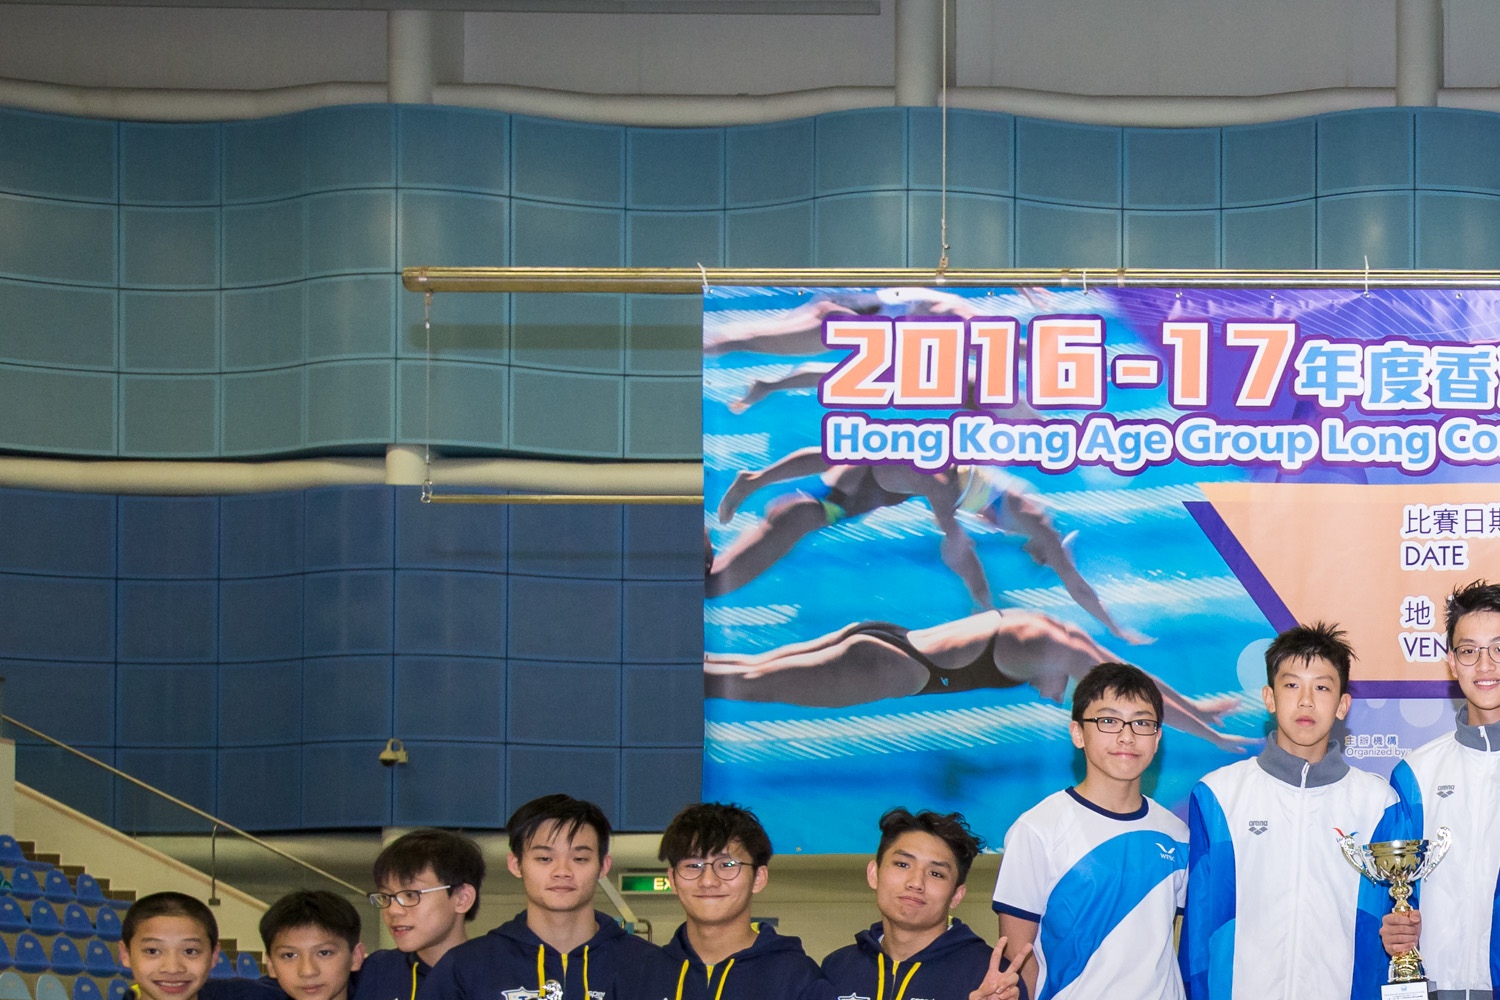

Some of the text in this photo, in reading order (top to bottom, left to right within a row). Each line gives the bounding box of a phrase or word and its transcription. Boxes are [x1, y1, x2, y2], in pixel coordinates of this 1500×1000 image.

[824, 321, 1296, 406] 2016-17
[832, 422, 944, 460] Hong
[959, 422, 1070, 462] Kong
[1084, 423, 1167, 464] Age
[1181, 423, 1314, 463] Group
[1327, 424, 1430, 464] Long
[1405, 545, 1465, 566] DATE
[1404, 600, 1431, 626] 地
[1403, 637, 1449, 658] VEN
[1346, 747, 1393, 758] Organized
[653, 877, 671, 891] EX
